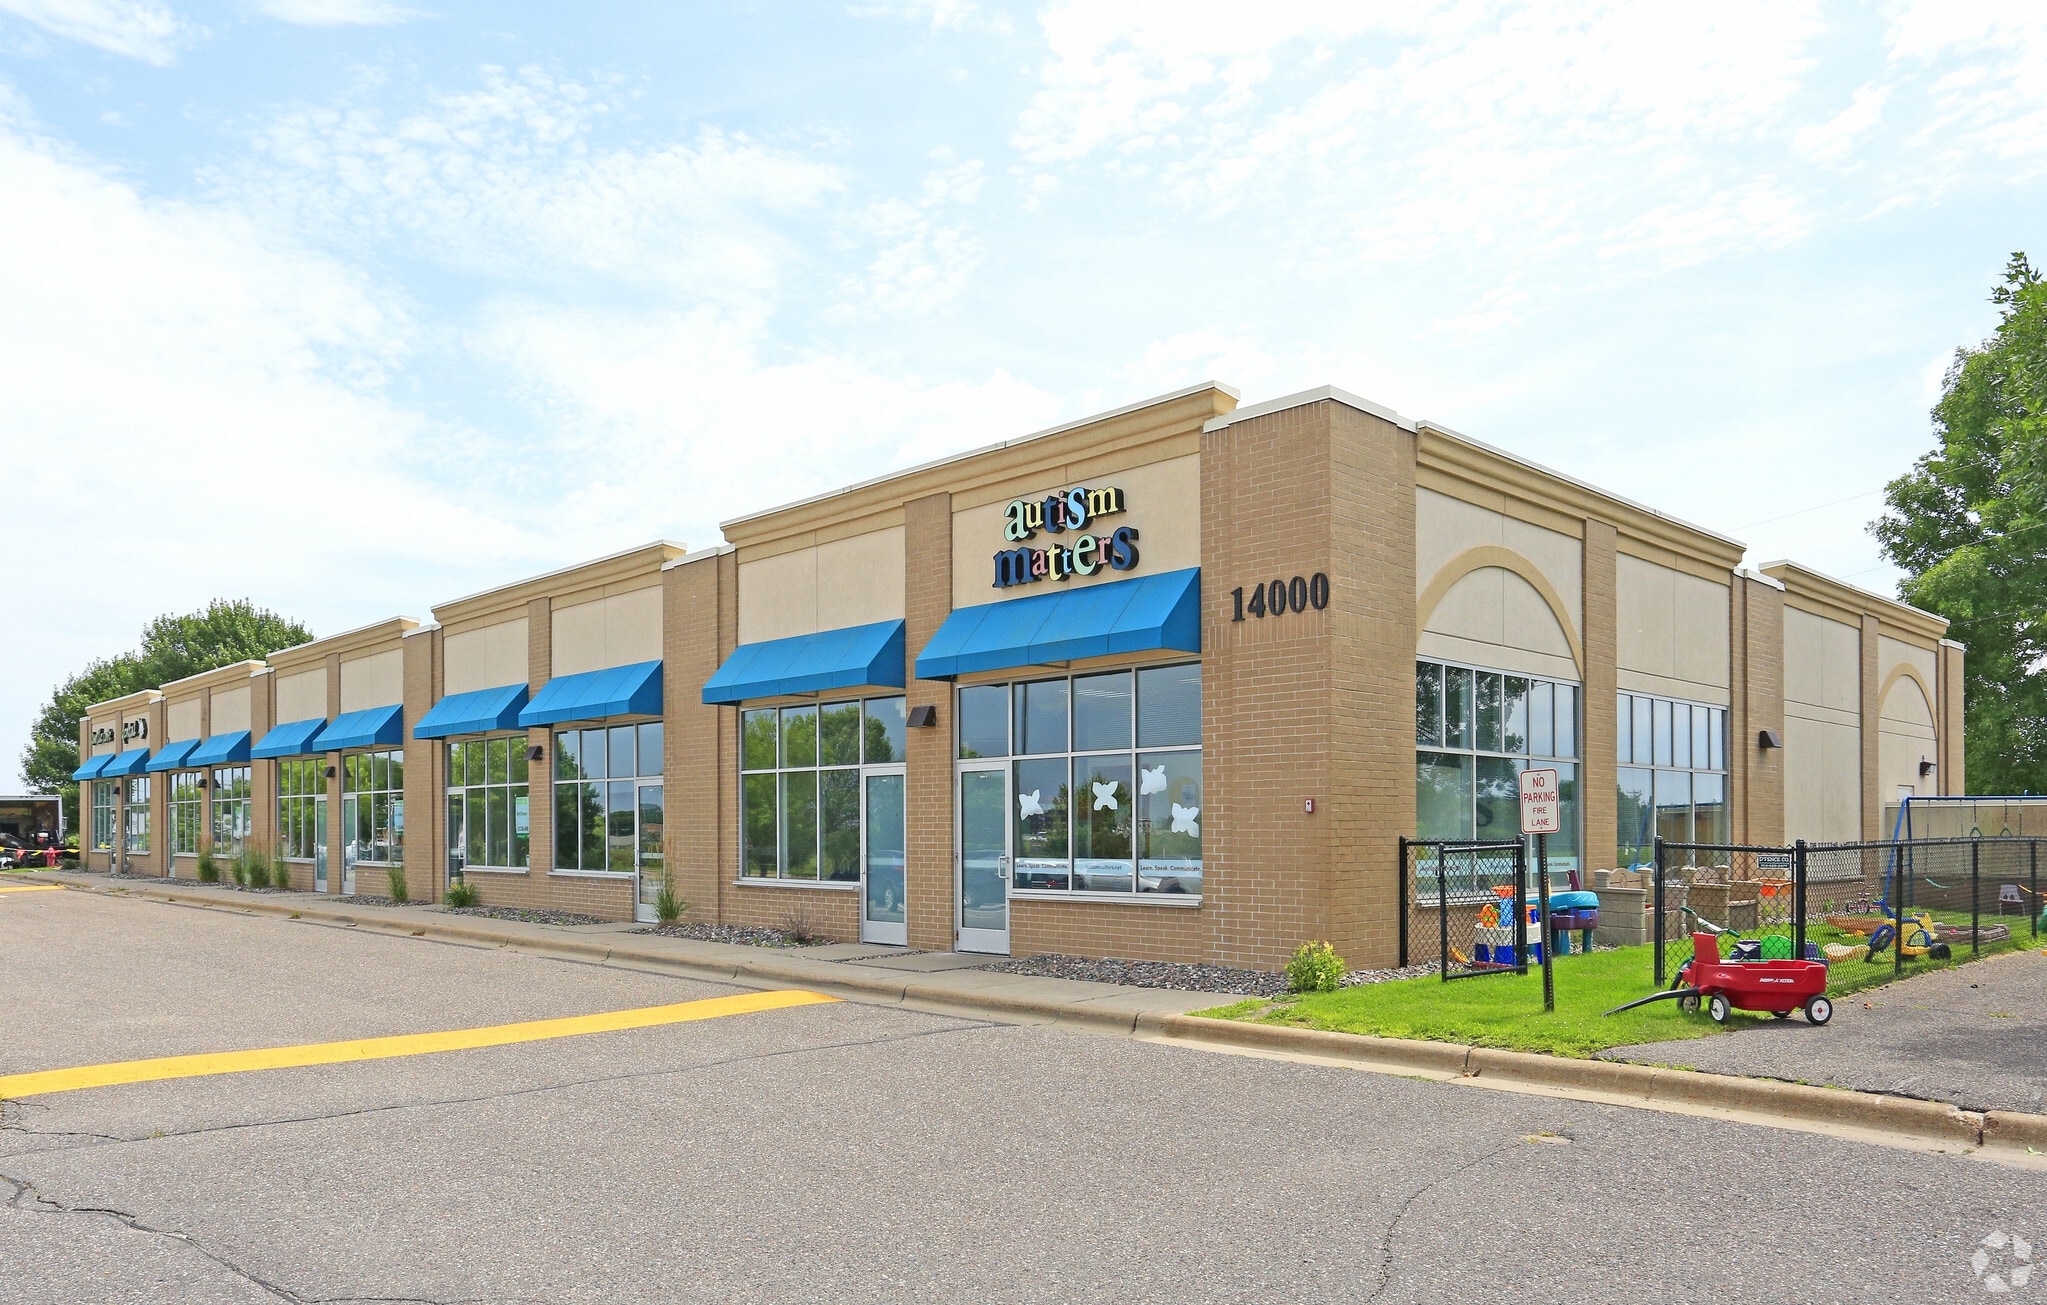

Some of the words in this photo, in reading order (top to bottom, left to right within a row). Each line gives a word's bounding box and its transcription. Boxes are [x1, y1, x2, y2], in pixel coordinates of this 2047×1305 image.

[1003, 486, 1126, 541] autism
[992, 526, 1139, 588] matters
[1230, 572, 1329, 622] 14000
[1532, 776, 1545, 788] NO
[1523, 791, 1556, 803] PARKING
[1532, 807, 1547, 815] FIRE
[1531, 818, 1549, 827] LANE
